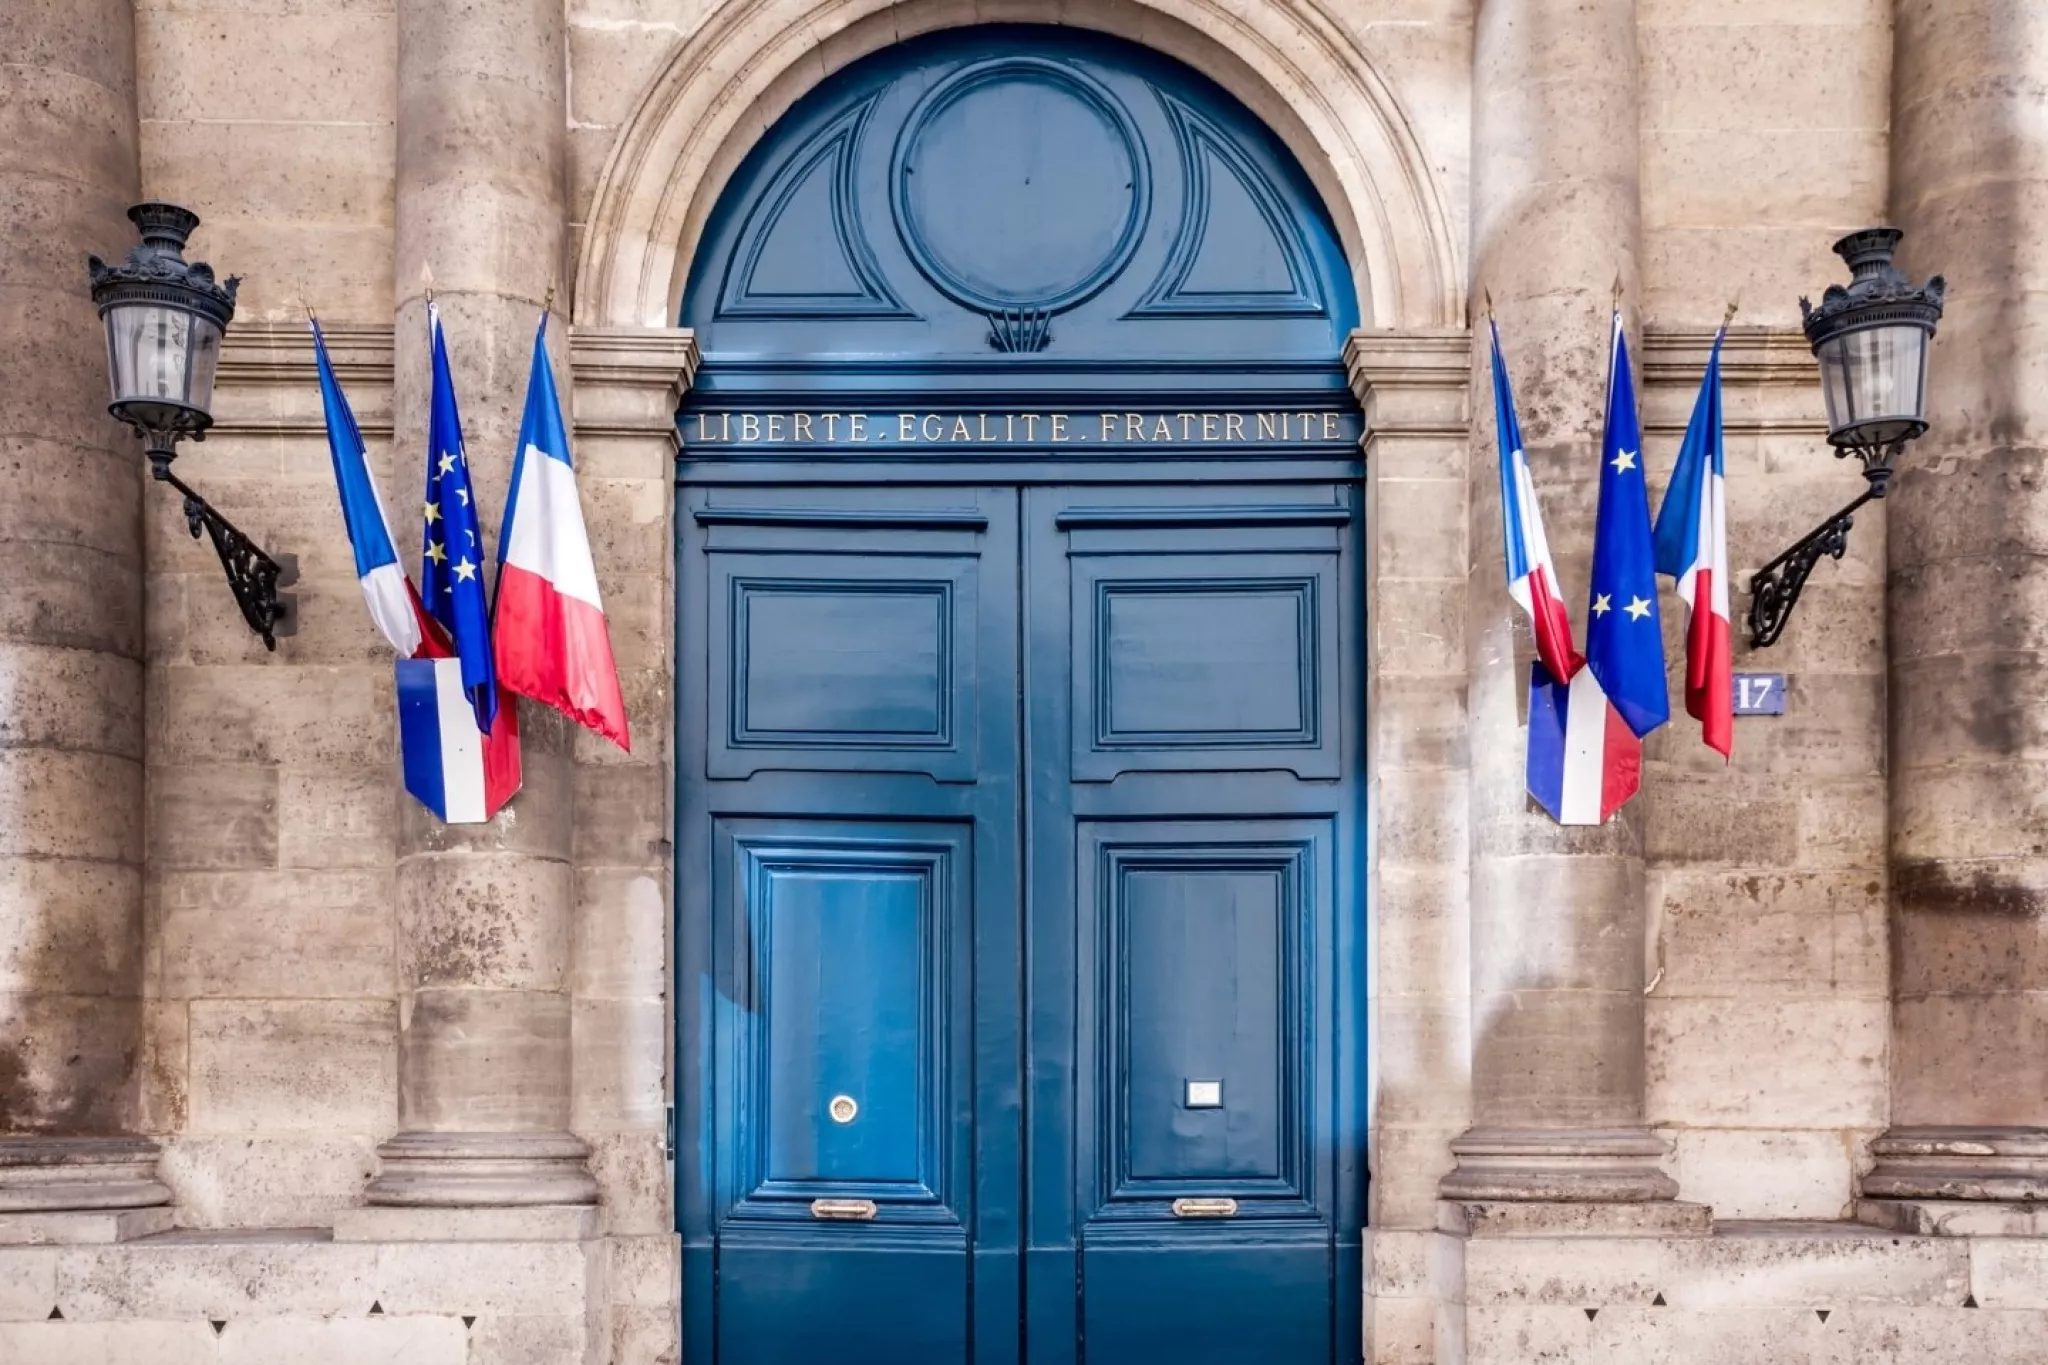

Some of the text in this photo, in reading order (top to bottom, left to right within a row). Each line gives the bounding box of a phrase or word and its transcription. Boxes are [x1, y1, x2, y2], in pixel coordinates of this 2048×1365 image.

[698, 413, 1341, 442] LIBERTE EGALITE FRATERNITE
[1738, 678, 1773, 709] 17
